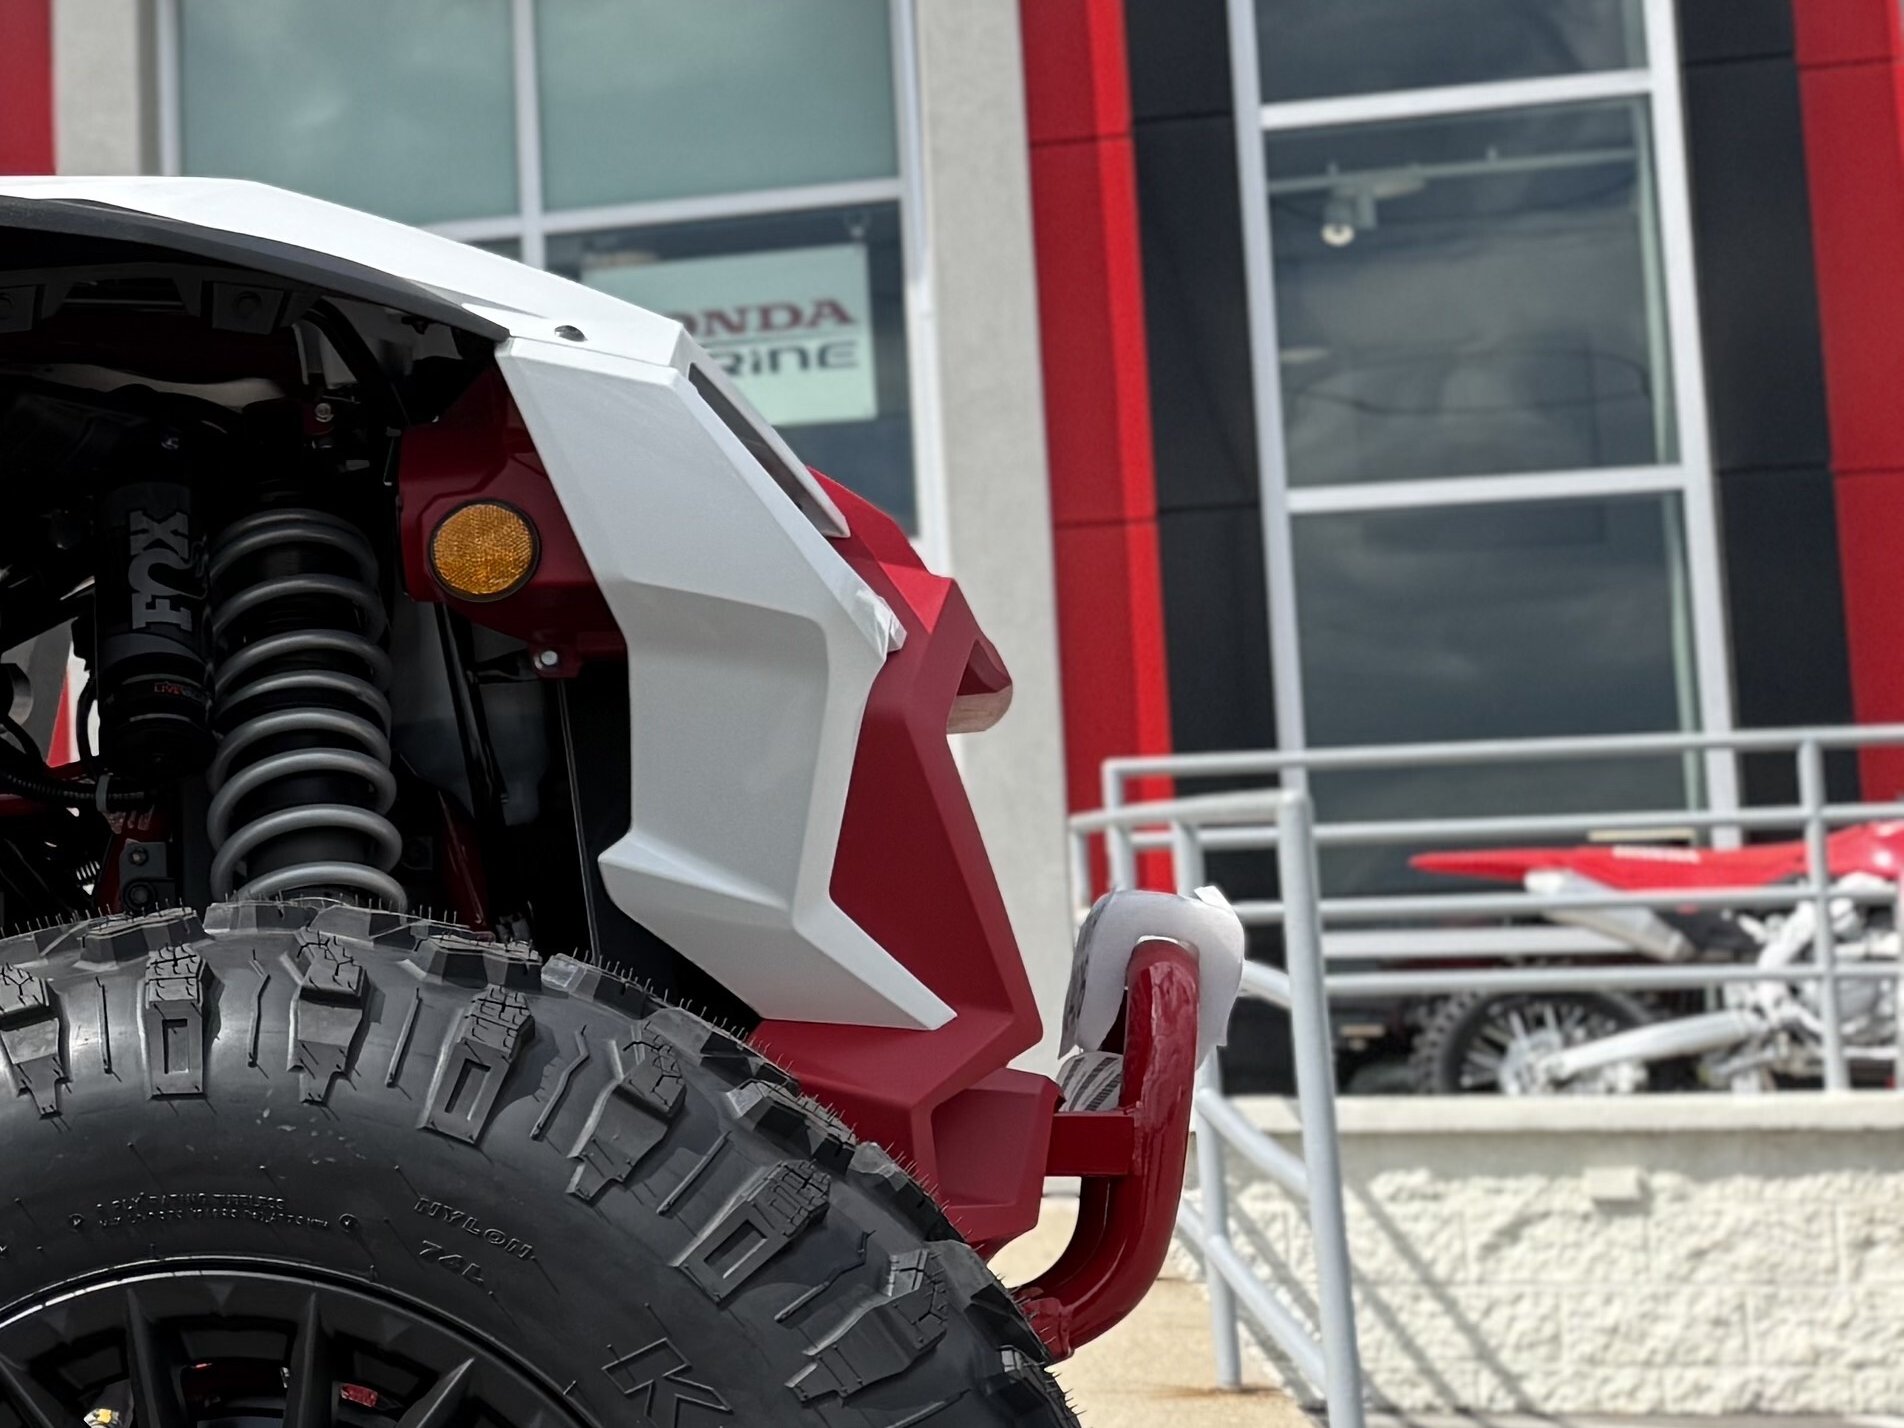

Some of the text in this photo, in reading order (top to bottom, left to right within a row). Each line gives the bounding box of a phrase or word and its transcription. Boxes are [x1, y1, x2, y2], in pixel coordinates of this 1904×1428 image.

[666, 298, 856, 337] ONDA
[128, 509, 206, 632] FOX
[414, 1197, 533, 1259] NYLON
